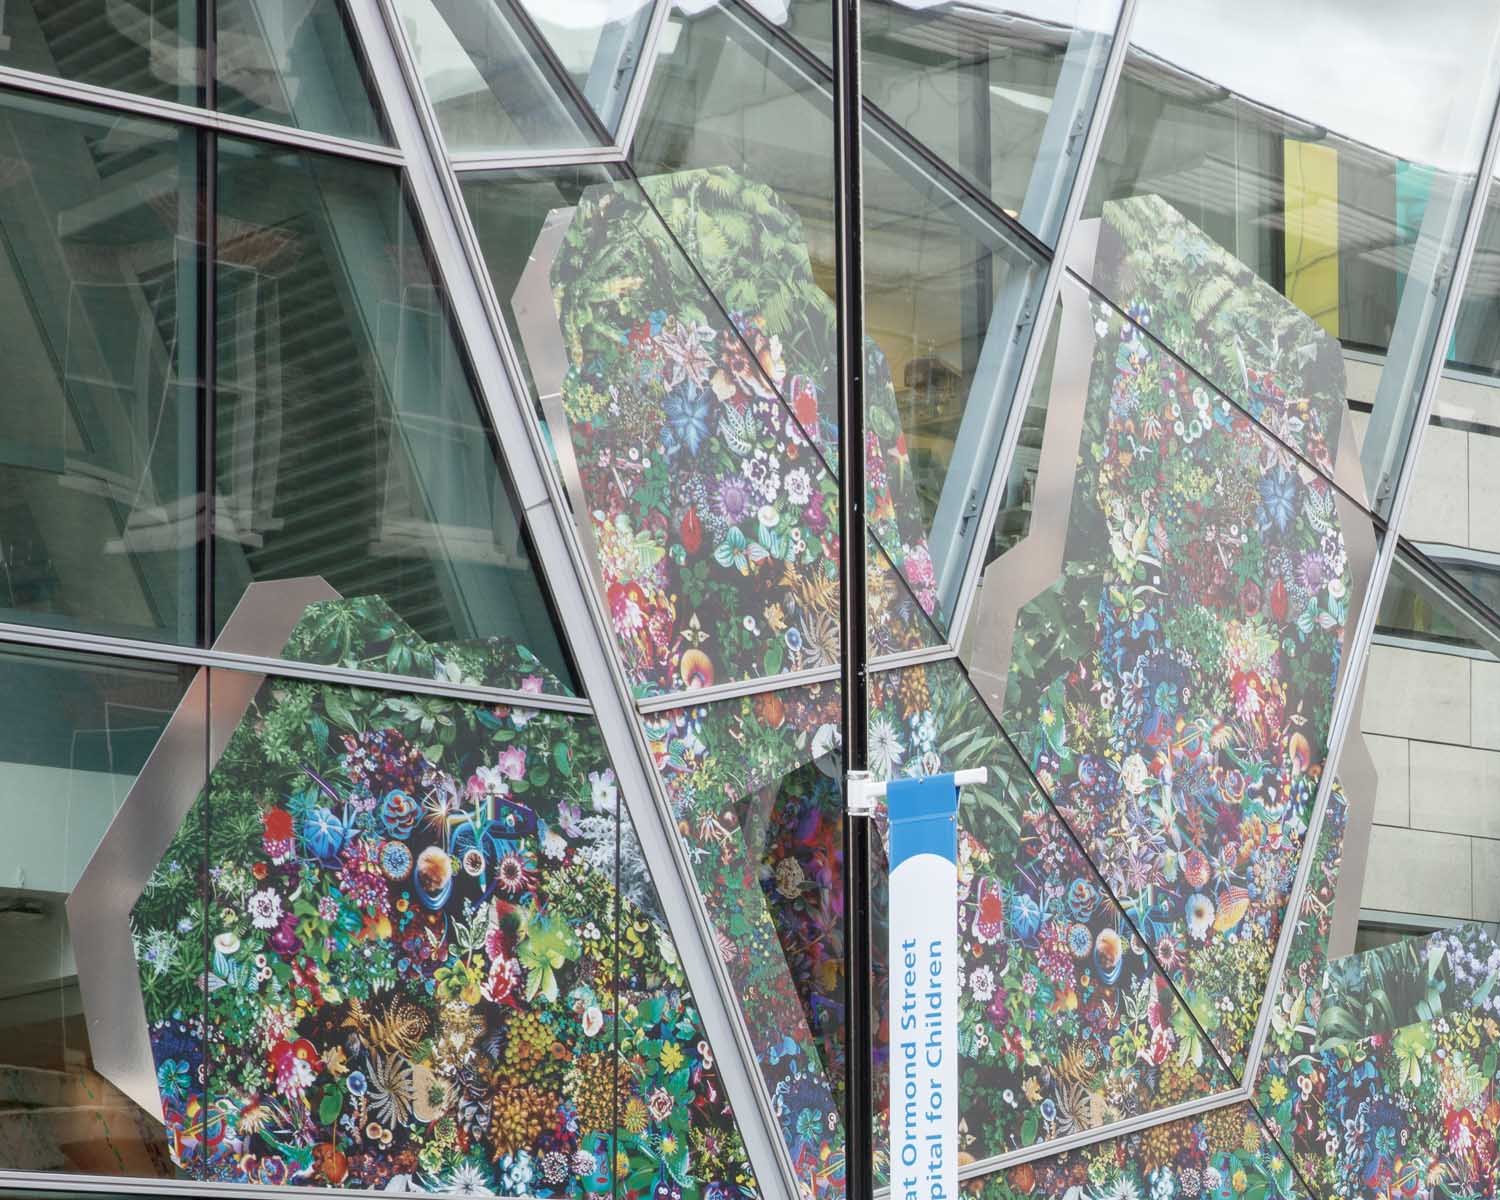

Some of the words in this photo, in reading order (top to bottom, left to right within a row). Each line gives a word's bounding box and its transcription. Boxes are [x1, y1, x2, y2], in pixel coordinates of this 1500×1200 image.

[901, 938, 917, 1030] Street
[925, 940, 942, 1068] Children
[901, 1042, 917, 1167] Ormond
[925, 1078, 942, 1123] for
